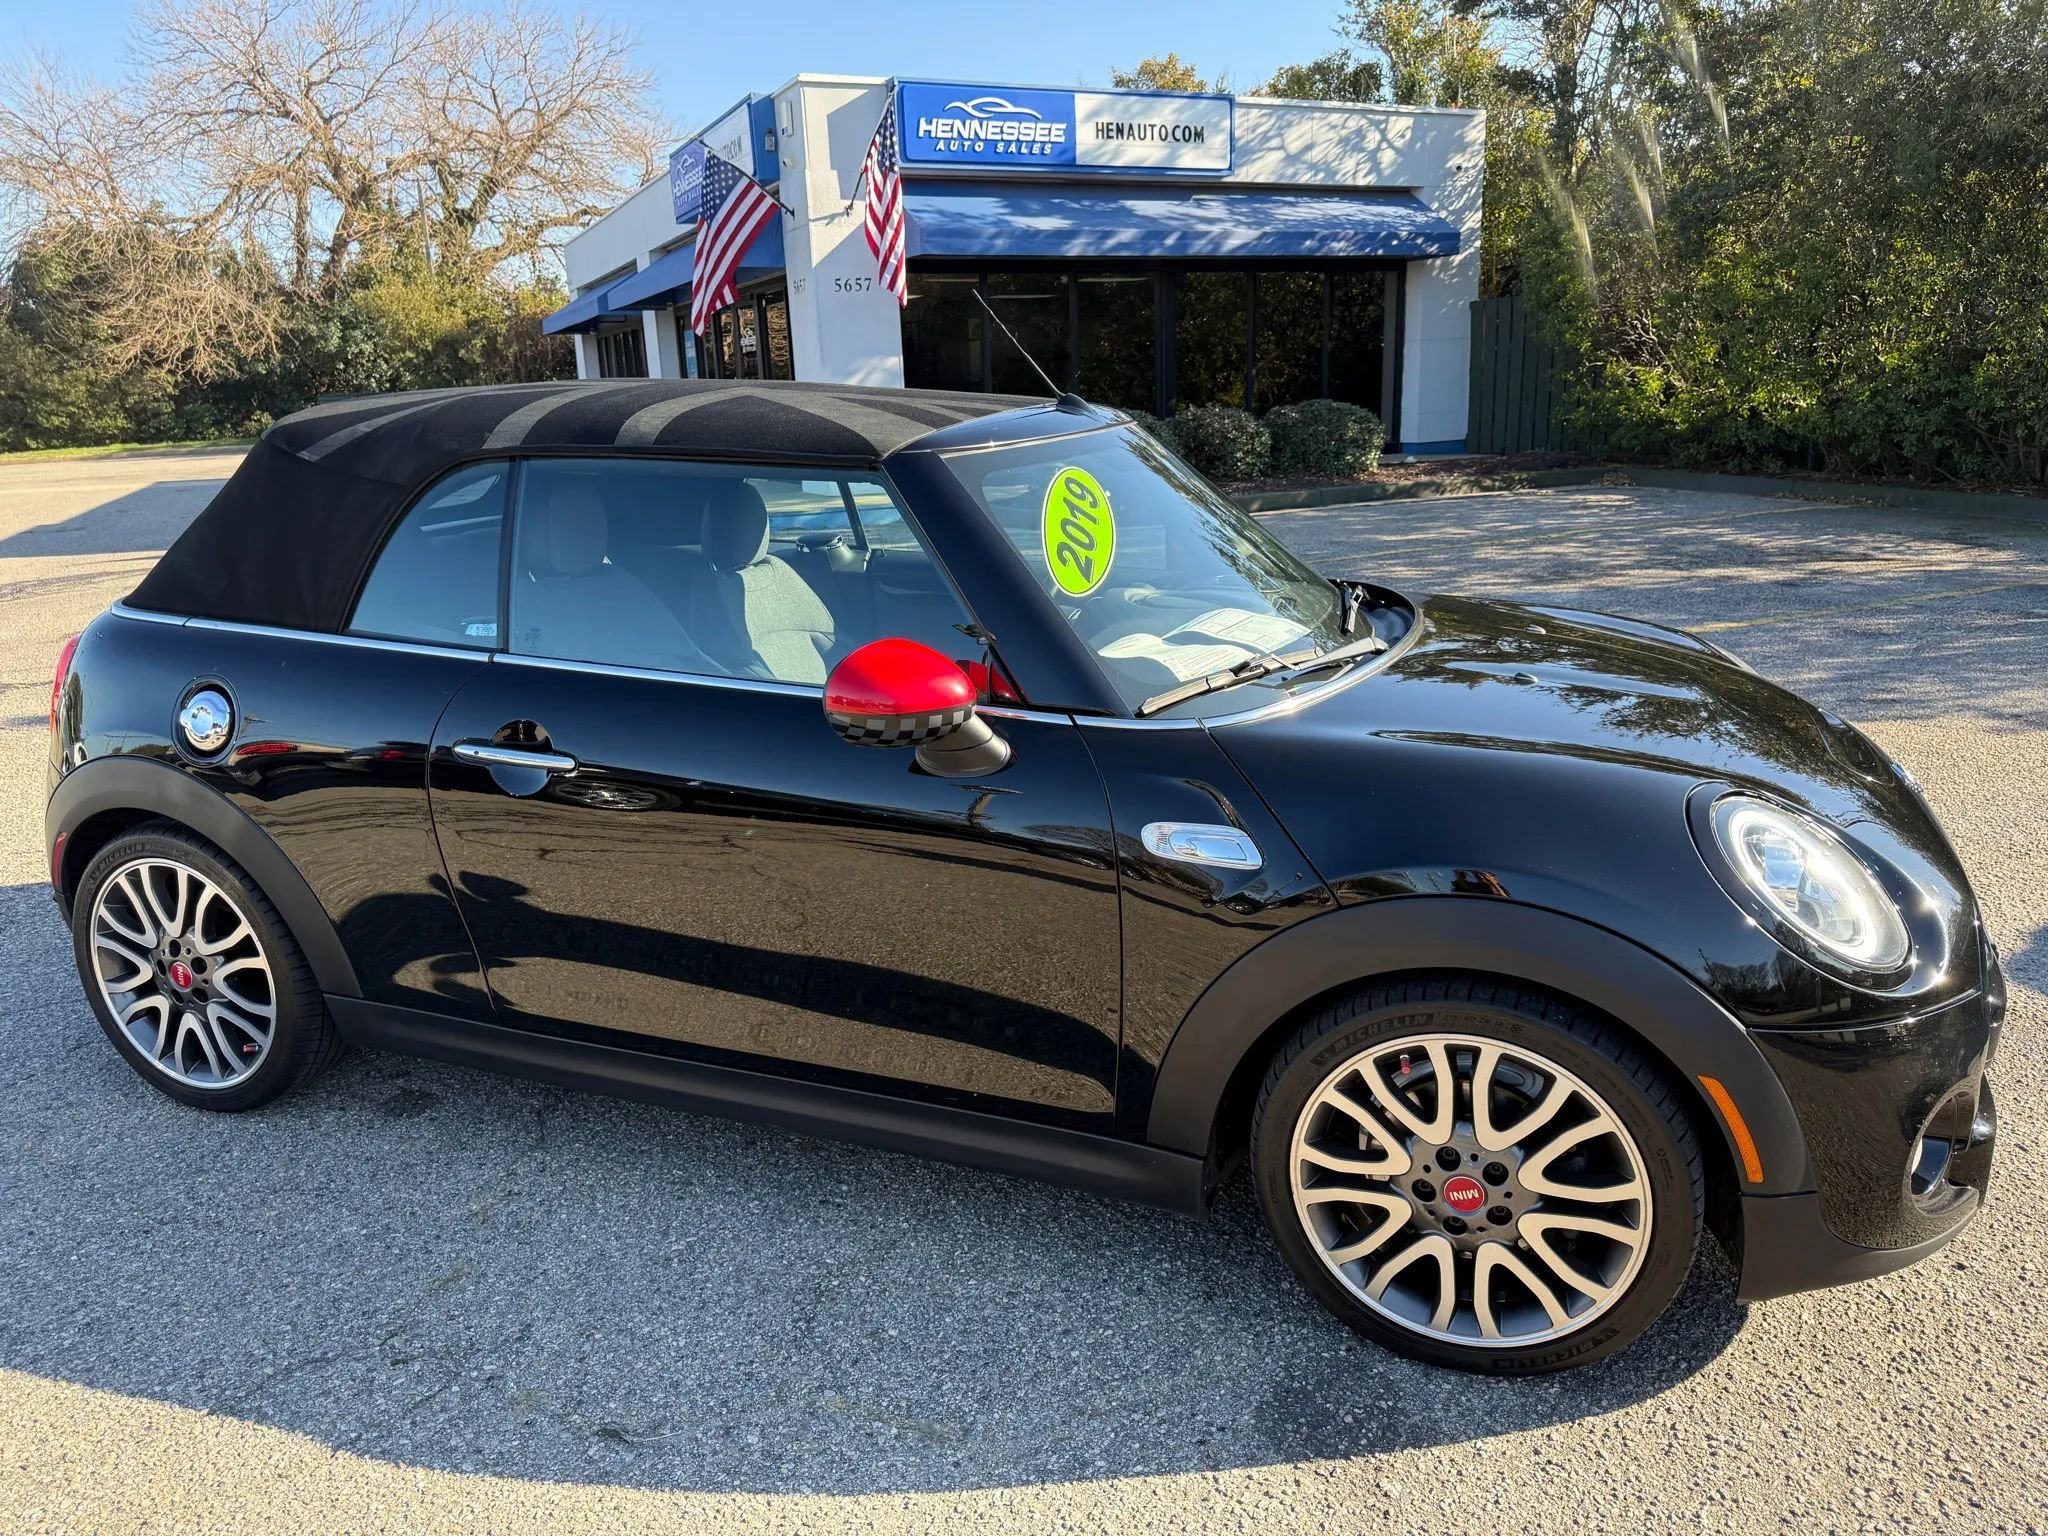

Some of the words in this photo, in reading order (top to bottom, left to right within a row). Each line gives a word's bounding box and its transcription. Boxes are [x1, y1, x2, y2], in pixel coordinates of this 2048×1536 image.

[918, 116, 1067, 143] HENNESSEE
[936, 139, 984, 152] AUTO
[996, 141, 1052, 155] SALES
[833, 277, 872, 293] 5657
[1056, 476, 1100, 584] 2019
[1333, 1013, 1429, 1051] MICHELIN
[1449, 1189, 1479, 1201] MINI
